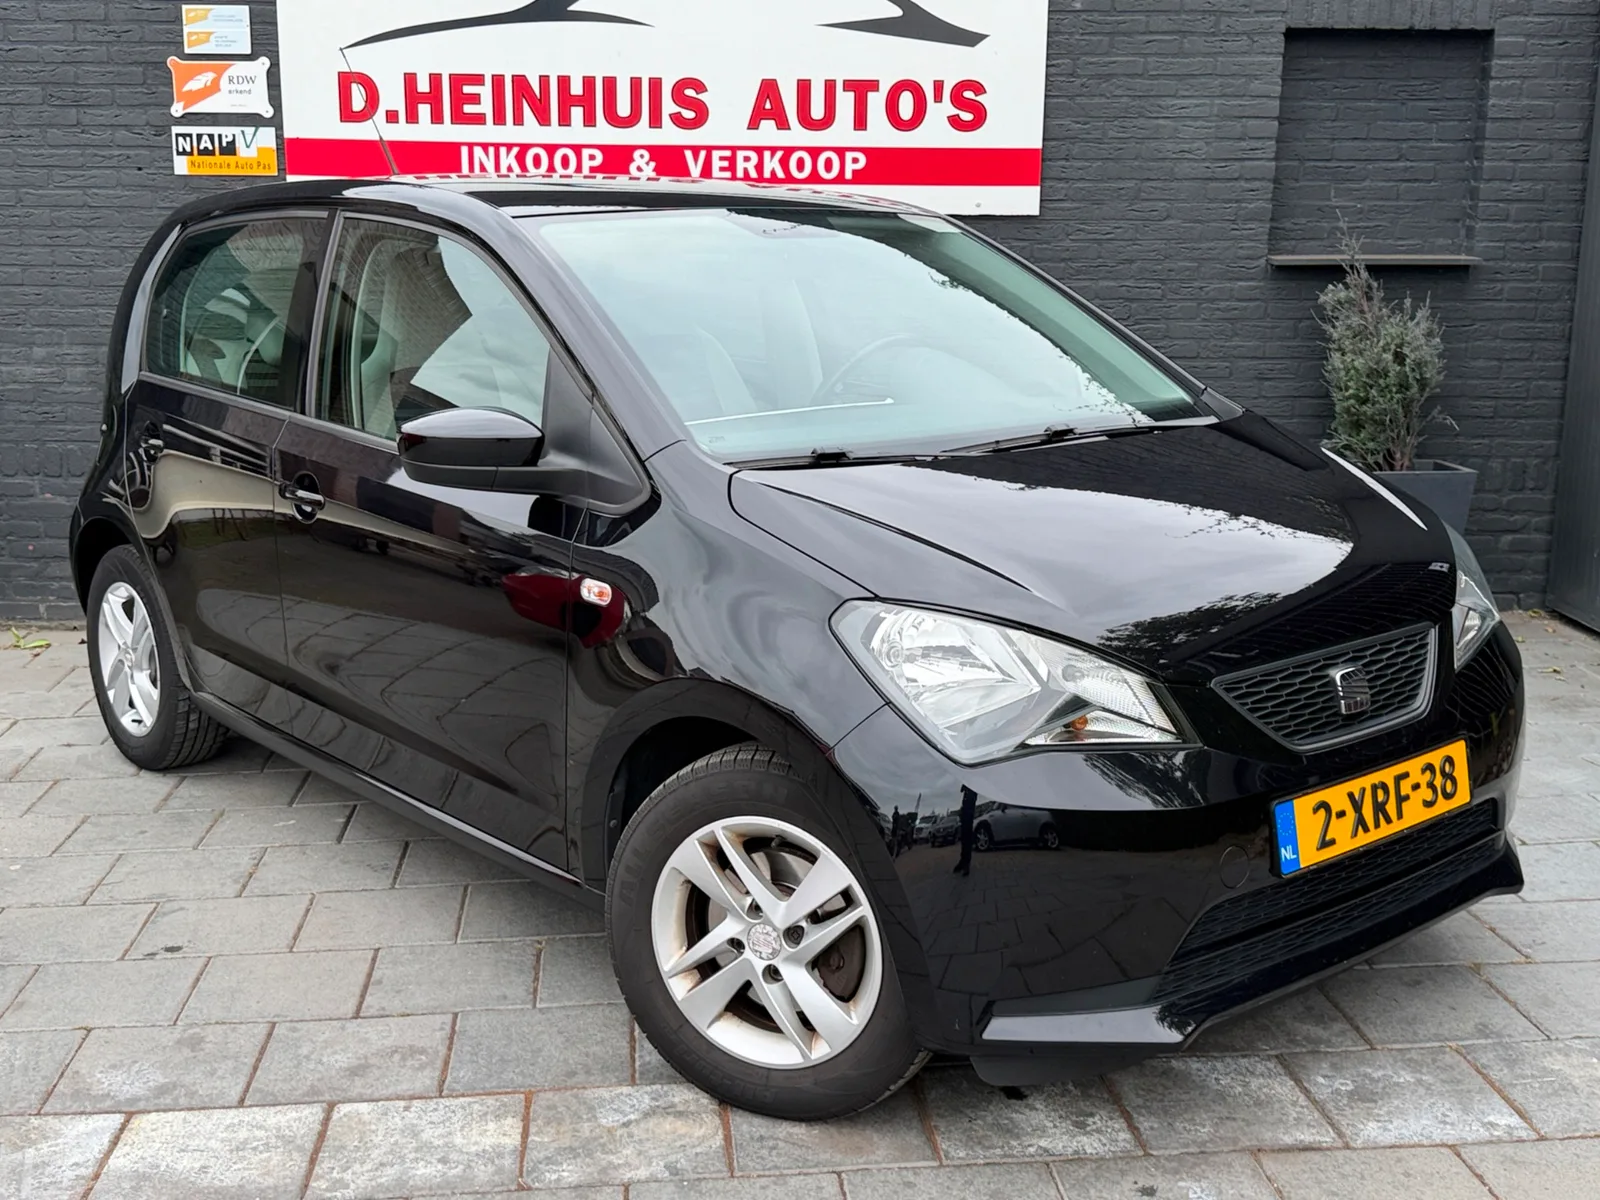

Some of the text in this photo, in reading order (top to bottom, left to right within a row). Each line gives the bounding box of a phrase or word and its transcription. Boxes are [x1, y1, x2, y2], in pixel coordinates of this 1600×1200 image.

[228, 75, 257, 85] RDW
[228, 87, 253, 95] erkend
[337, 71, 988, 132] D.HEINHUIS AUTO'S
[190, 160, 272, 170] Nationale Auto Pas
[460, 145, 867, 180] INKOOP & VERKOOP
[1312, 754, 1458, 851] 2-XRF-38
[1281, 845, 1297, 862] NL
